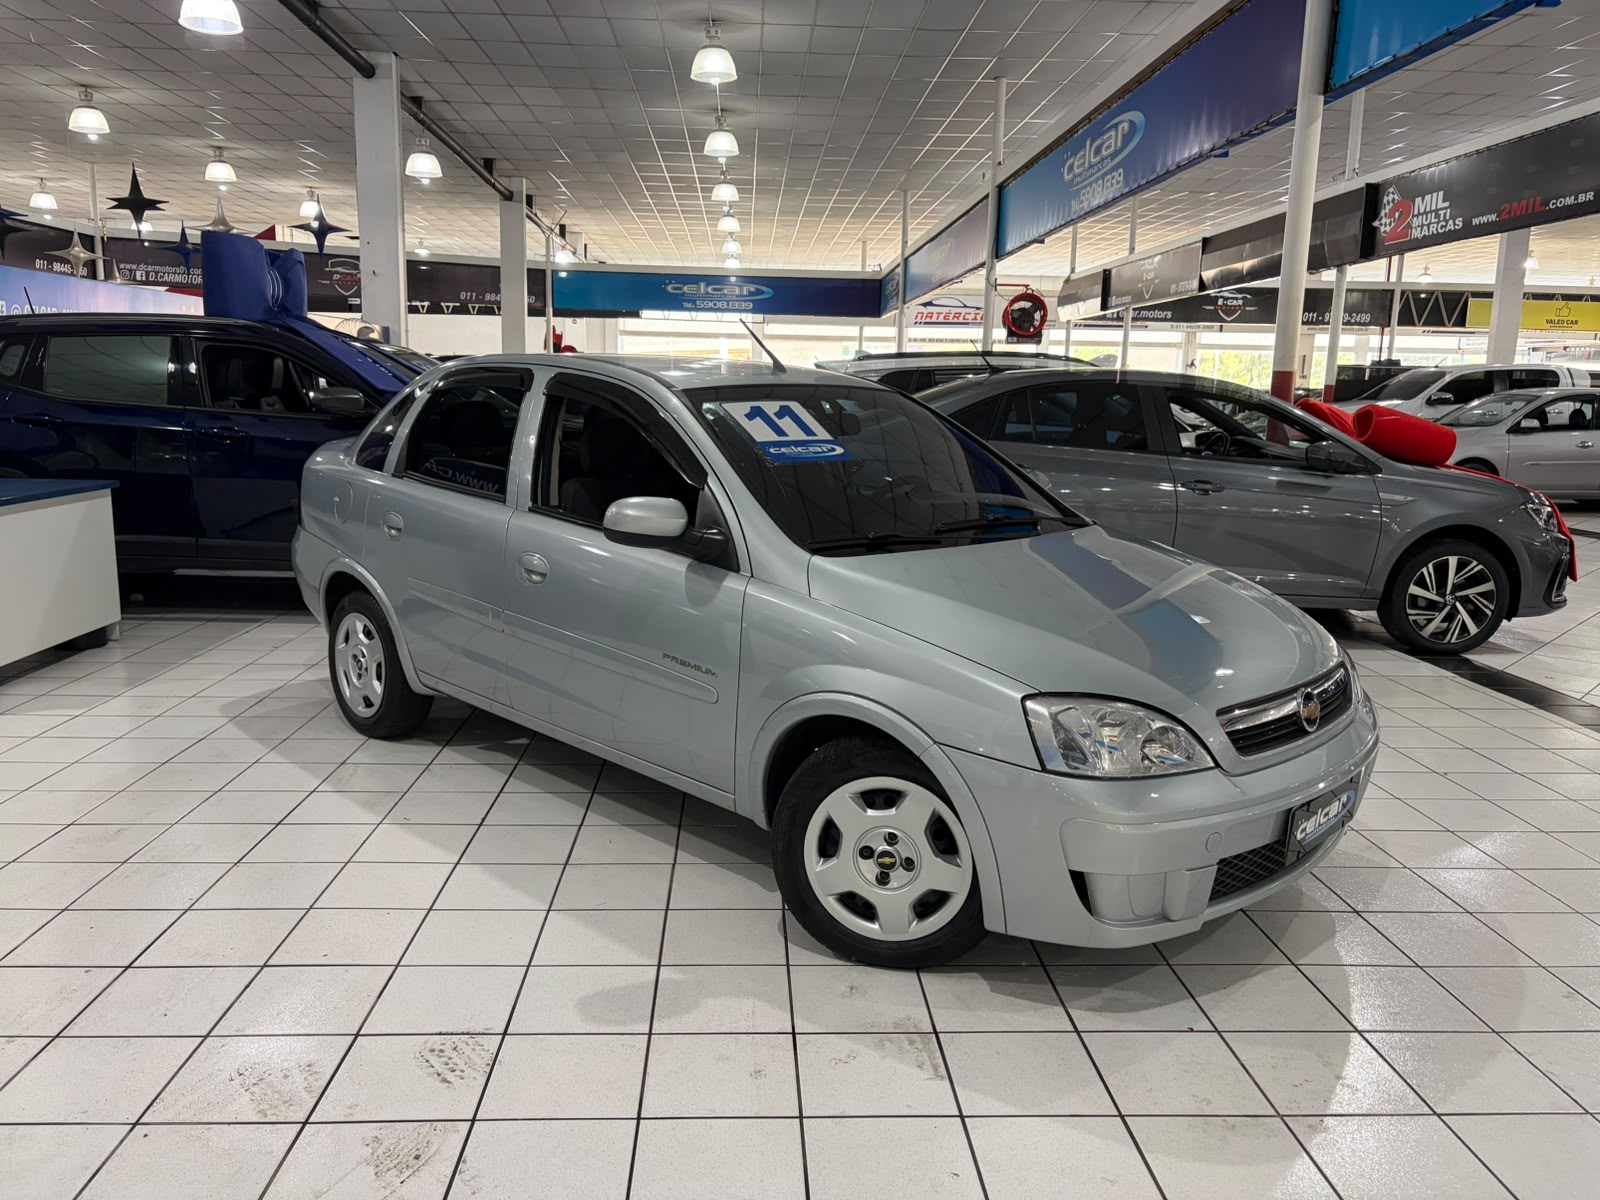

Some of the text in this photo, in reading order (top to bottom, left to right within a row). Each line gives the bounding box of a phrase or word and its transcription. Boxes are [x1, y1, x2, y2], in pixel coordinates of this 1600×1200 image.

[1063, 120, 1130, 182] celcar
[1384, 190, 1450, 245] 2 MIL
[1412, 208, 1450, 228] MULTI
[1411, 217, 1463, 240] MARCAS
[35, 258, 47, 270] 011
[459, 291, 476, 301] 011
[665, 282, 757, 297] celcar
[1302, 312, 1317, 323] 011
[743, 404, 819, 438] 11
[768, 445, 832, 453] celcar
[662, 651, 718, 678] PREMIUM
[1296, 793, 1348, 841] celcar
